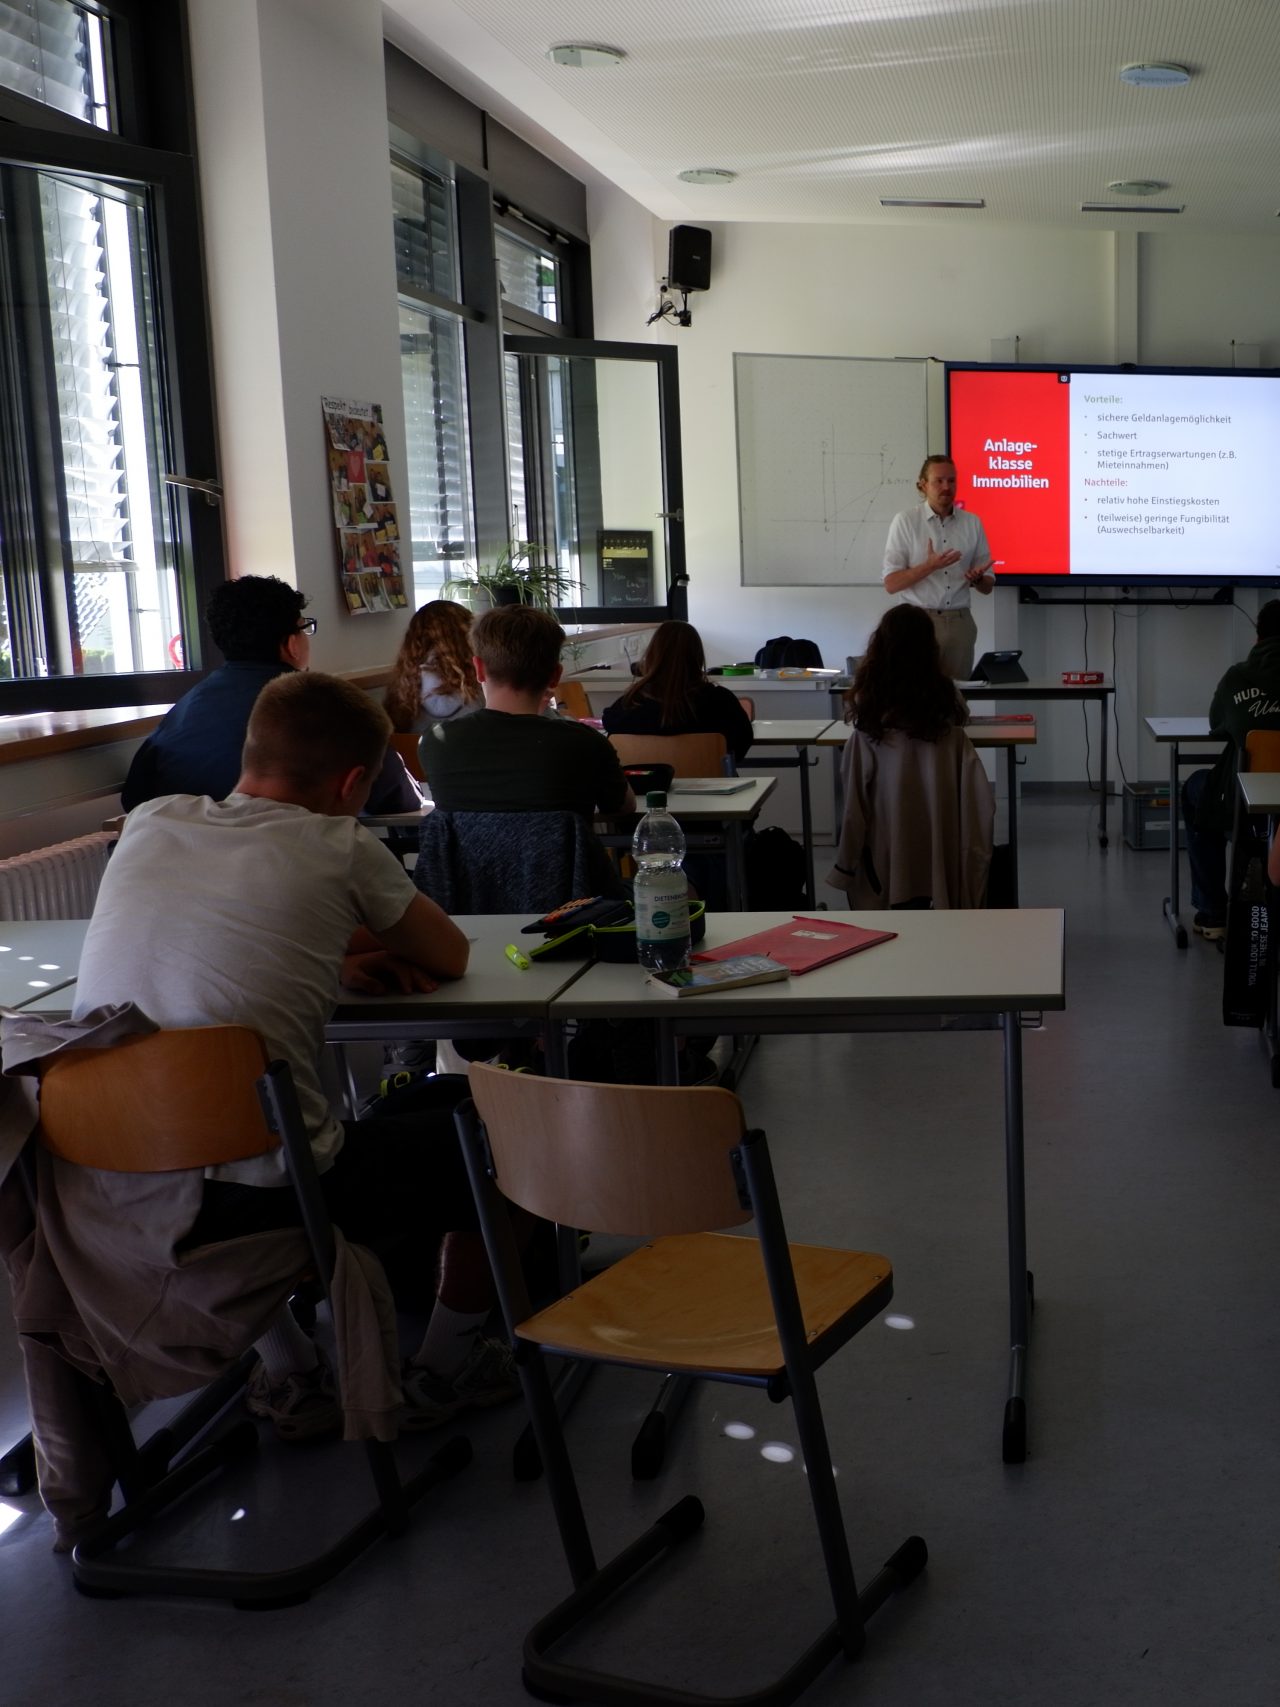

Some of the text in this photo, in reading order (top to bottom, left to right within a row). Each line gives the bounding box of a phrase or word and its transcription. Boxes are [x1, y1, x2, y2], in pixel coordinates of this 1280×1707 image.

[1084, 395, 1123, 404] Vorteile:
[1097, 413, 1232, 425] sichere Geldanlagemöglichkeit
[1097, 431, 1137, 440] Sachwert
[984, 438, 1038, 455] Anlage-
[1097, 449, 1237, 460] stetige Ertragserwartungen (z.B.
[988, 457, 1033, 470] klasse
[1097, 461, 1169, 471] Mieteinnahmen)
[973, 475, 1050, 489] Immobilien
[1084, 478, 1128, 487] Nachteile:
[1097, 496, 1220, 508] relativ hohe Einstiegskosten
[1097, 514, 1230, 525] (teilweise) geringe Fungibilität
[1097, 526, 1185, 536] (Auswechselbarkeit)
[1251, 905, 1260, 929] GOOD
[1260, 906, 1269, 933] JEANS
